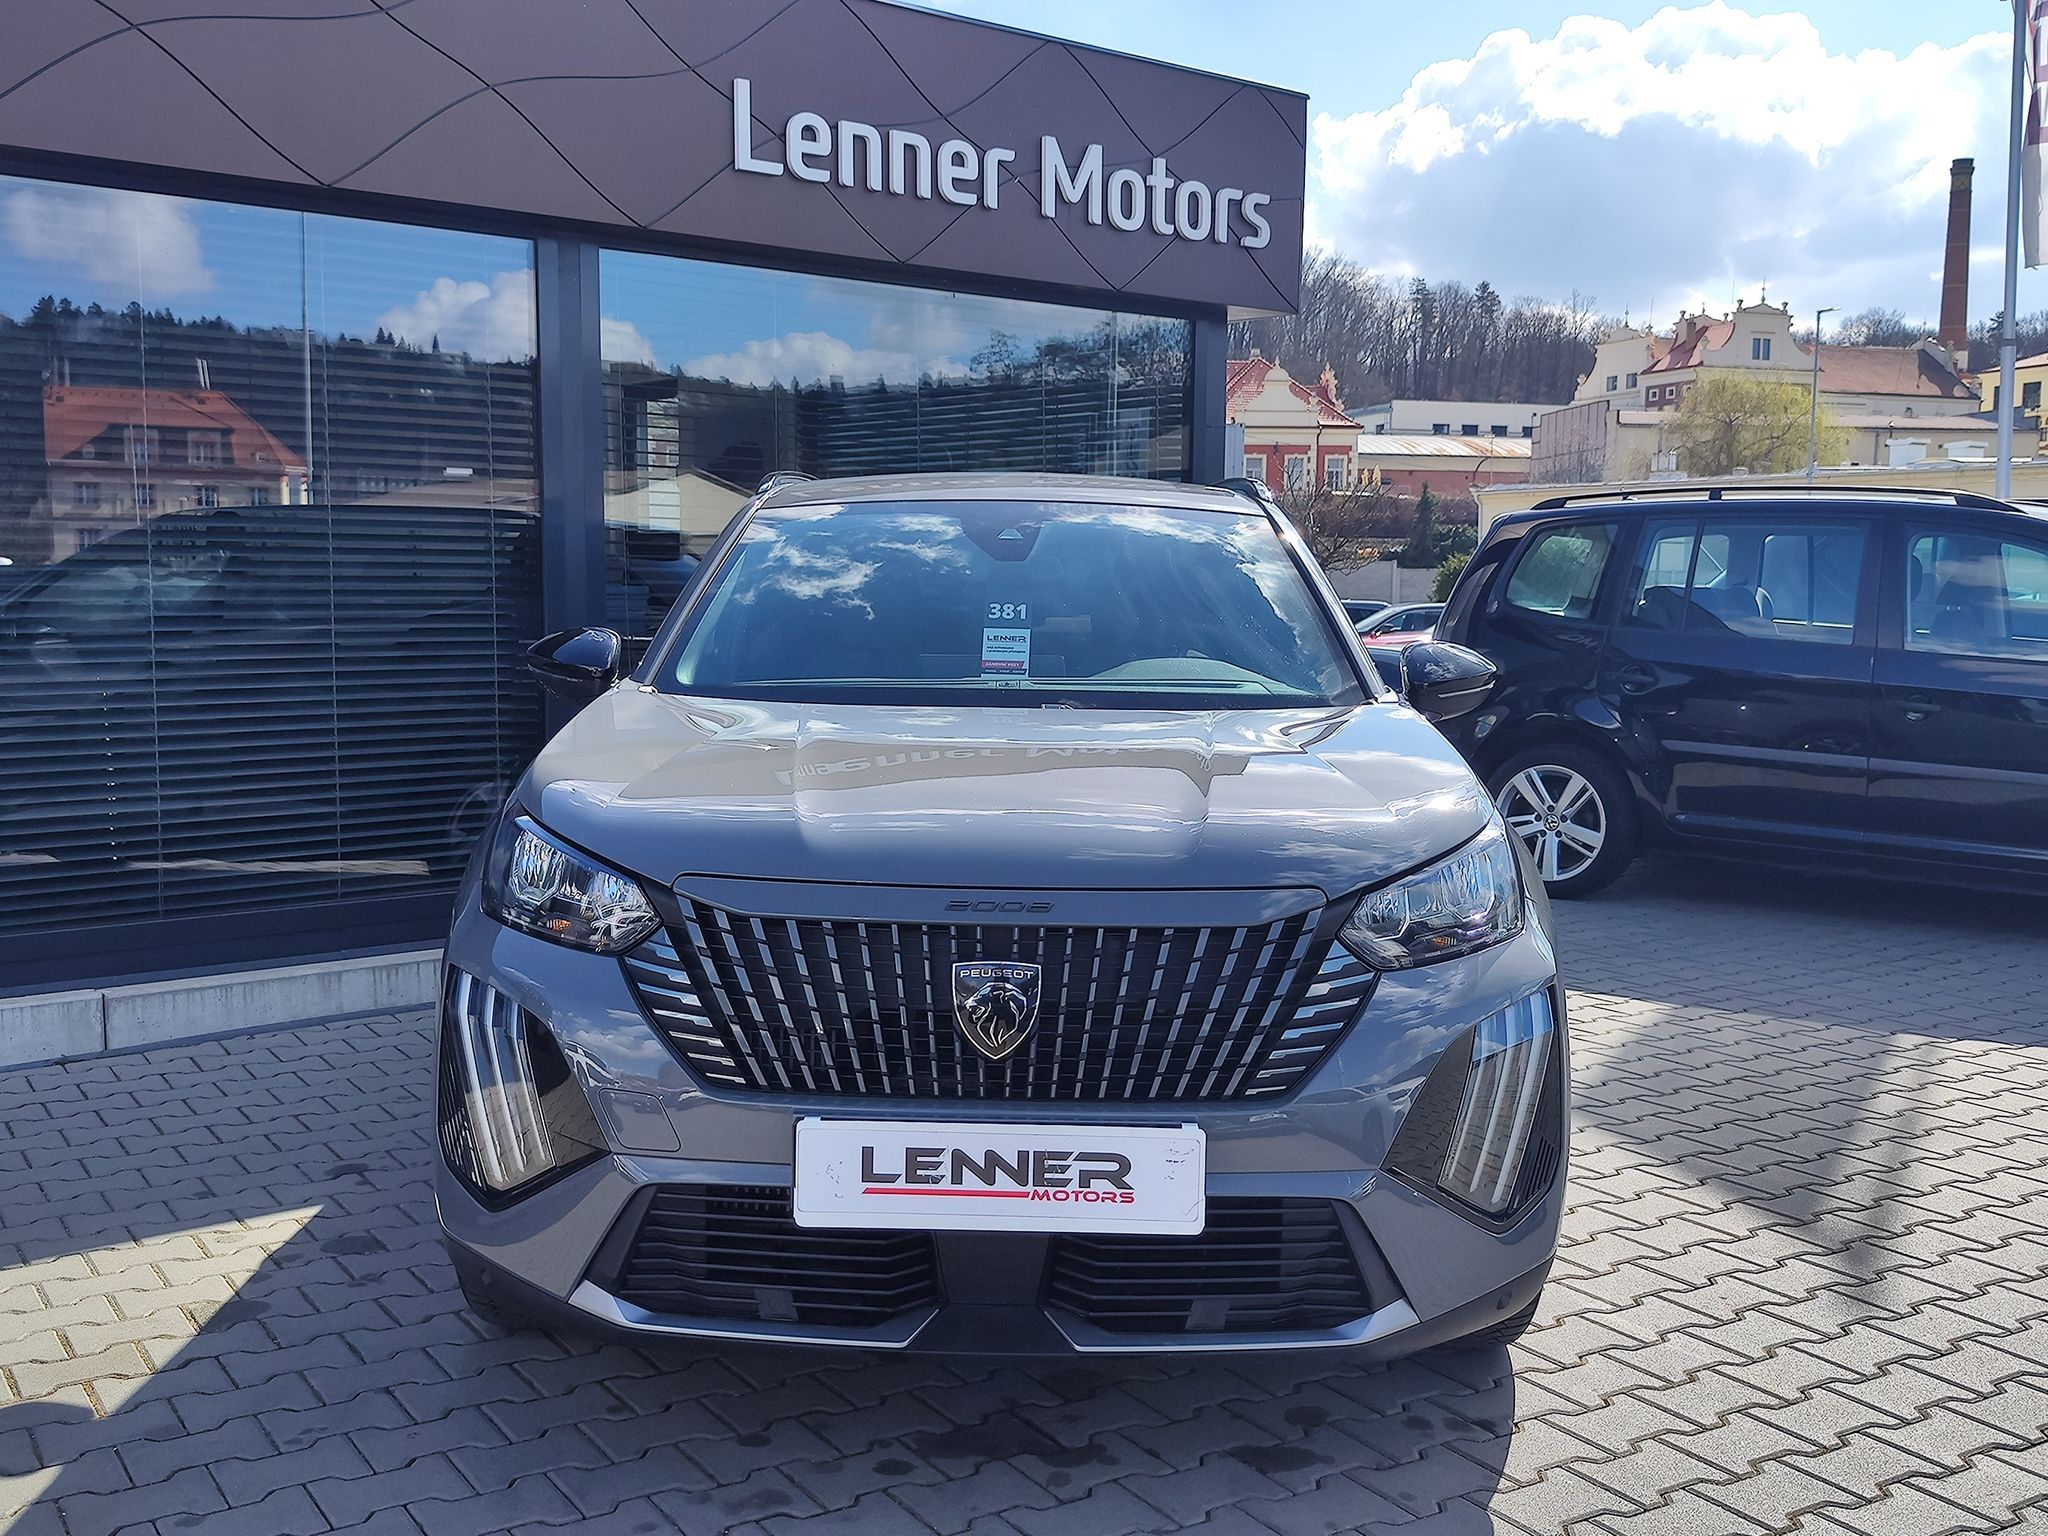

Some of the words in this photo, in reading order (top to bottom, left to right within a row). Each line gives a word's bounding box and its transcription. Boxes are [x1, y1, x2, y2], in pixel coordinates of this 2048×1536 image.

[733, 77, 1016, 210] Lenner
[1039, 134, 1272, 249] Motors
[988, 602, 1028, 620] 381
[986, 634, 1027, 643] LENNER
[944, 900, 1054, 913] 2008
[960, 969, 1036, 979] PEUGEOT
[861, 1145, 1135, 1190] LENNER
[1030, 1189, 1135, 1205] MOTORS
